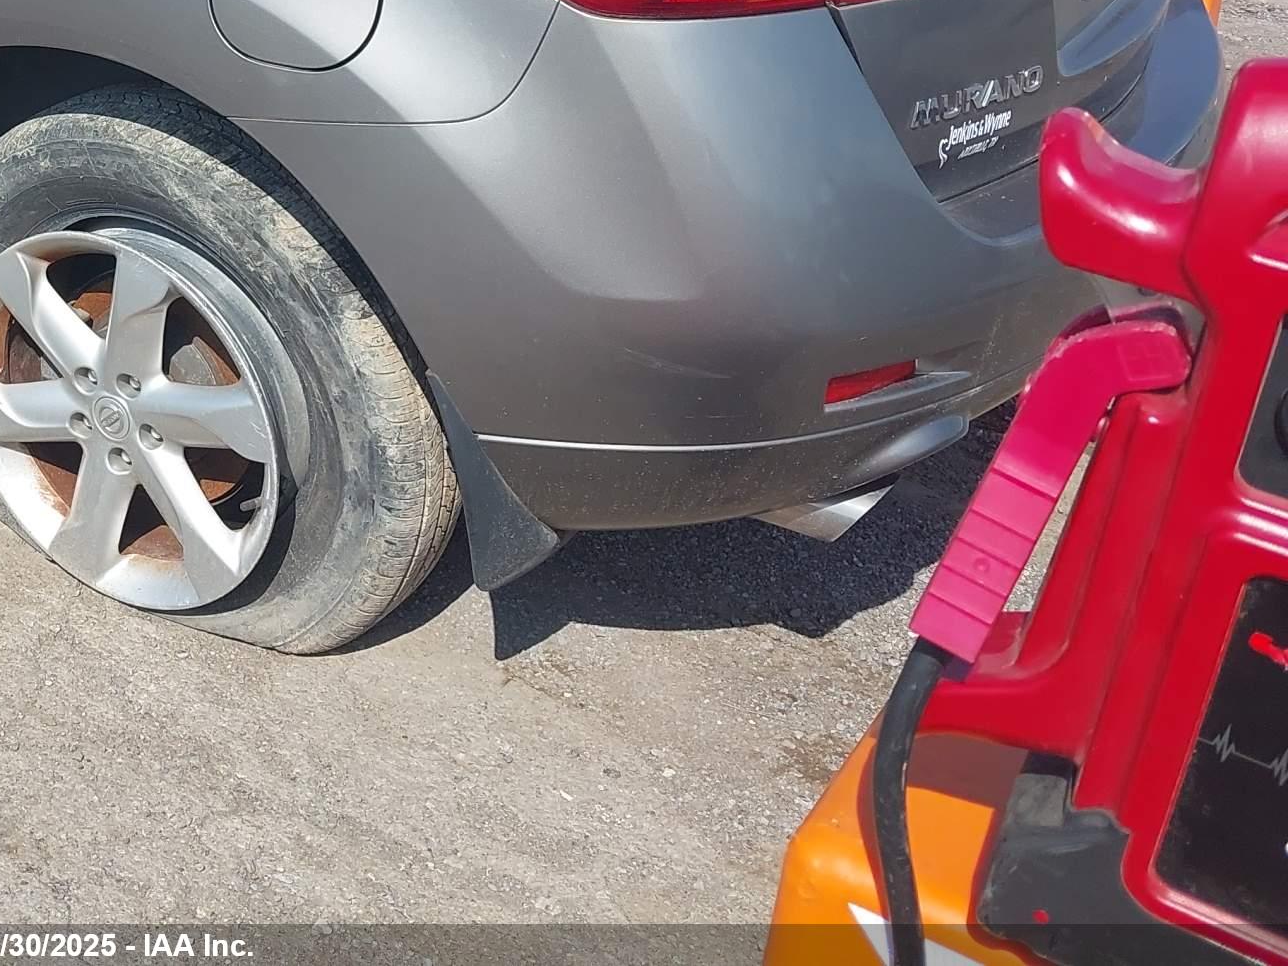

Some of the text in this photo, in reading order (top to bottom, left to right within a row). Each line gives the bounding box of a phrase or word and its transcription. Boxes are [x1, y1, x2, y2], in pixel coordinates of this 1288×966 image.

[910, 65, 1044, 129] MURANO
[945, 120, 979, 151] Jenkins
[983, 110, 1012, 136] Wynne
